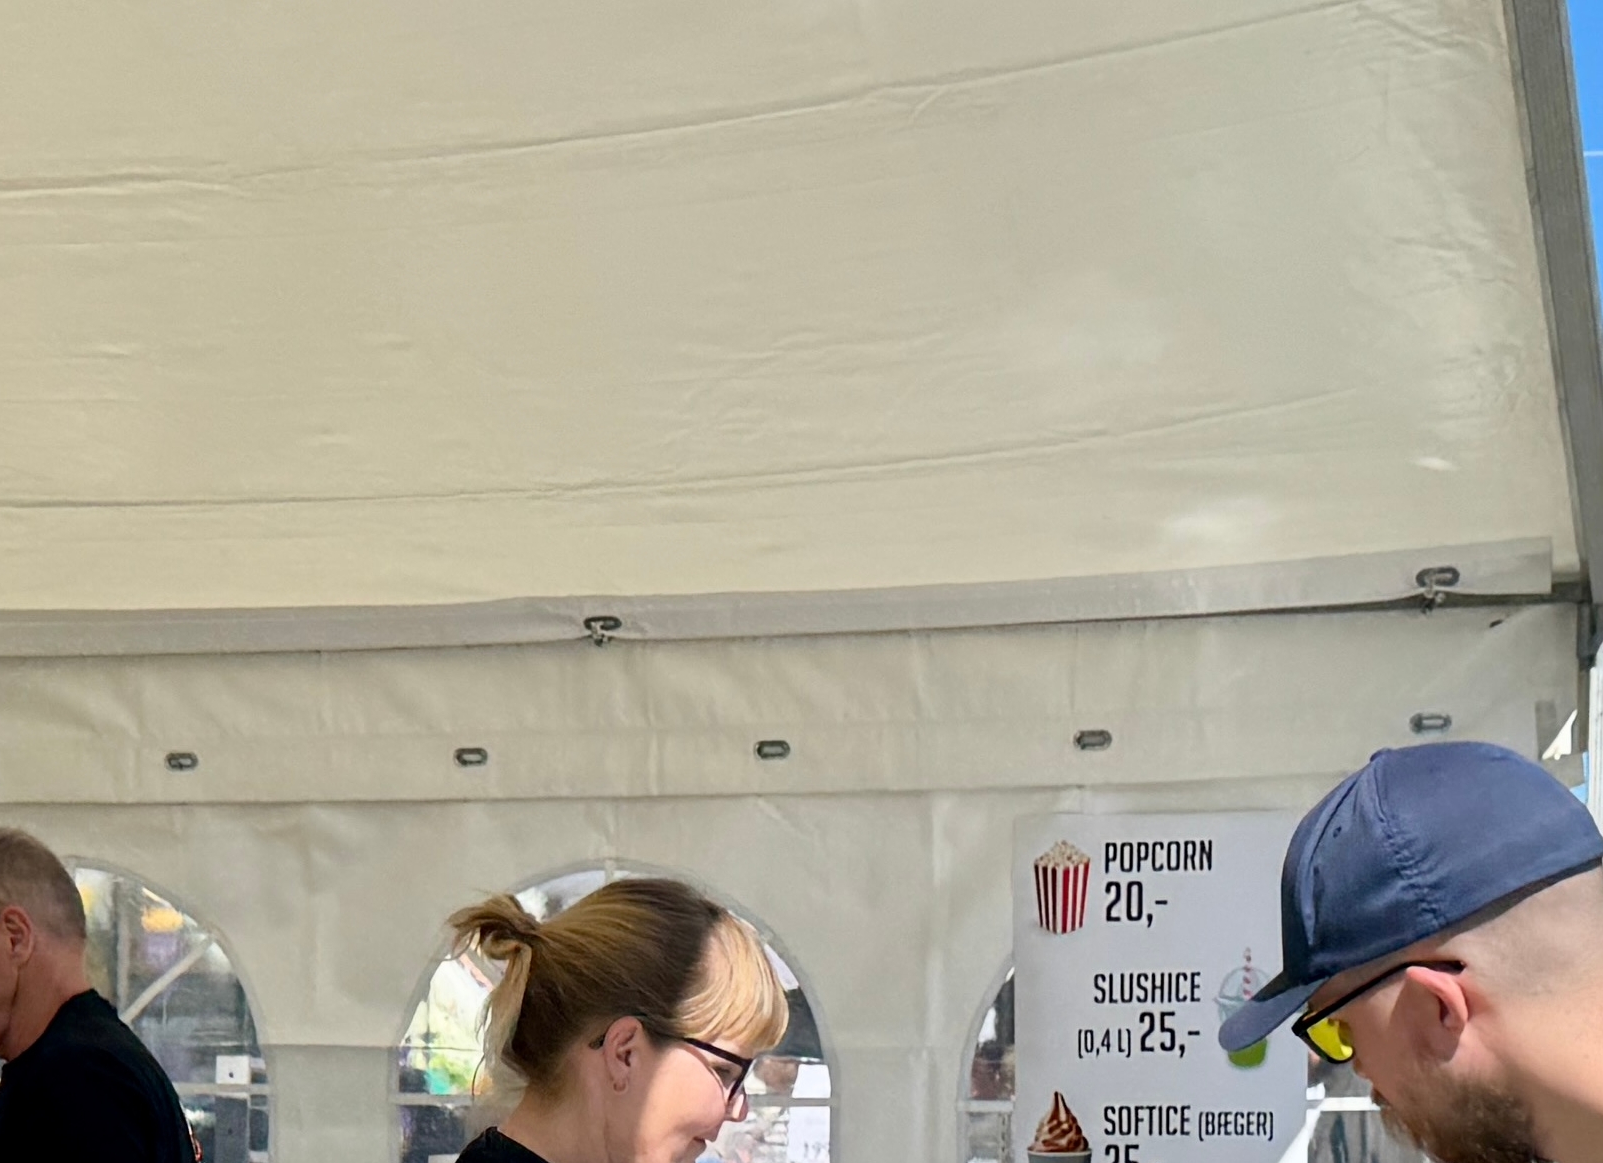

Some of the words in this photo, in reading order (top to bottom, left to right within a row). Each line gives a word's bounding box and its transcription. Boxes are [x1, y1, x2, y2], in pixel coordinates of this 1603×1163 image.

[1104, 840, 1213, 873] POPCORN
[1105, 881, 1168, 928] 20,-
[1093, 972, 1201, 1003] SLUSHICE
[1078, 1028, 1111, 1059] (0,4
[1139, 1011, 1200, 1058] 25,-
[1103, 1105, 1191, 1136] SOFTICE
[1198, 1111, 1274, 1141] (BÆGER)
